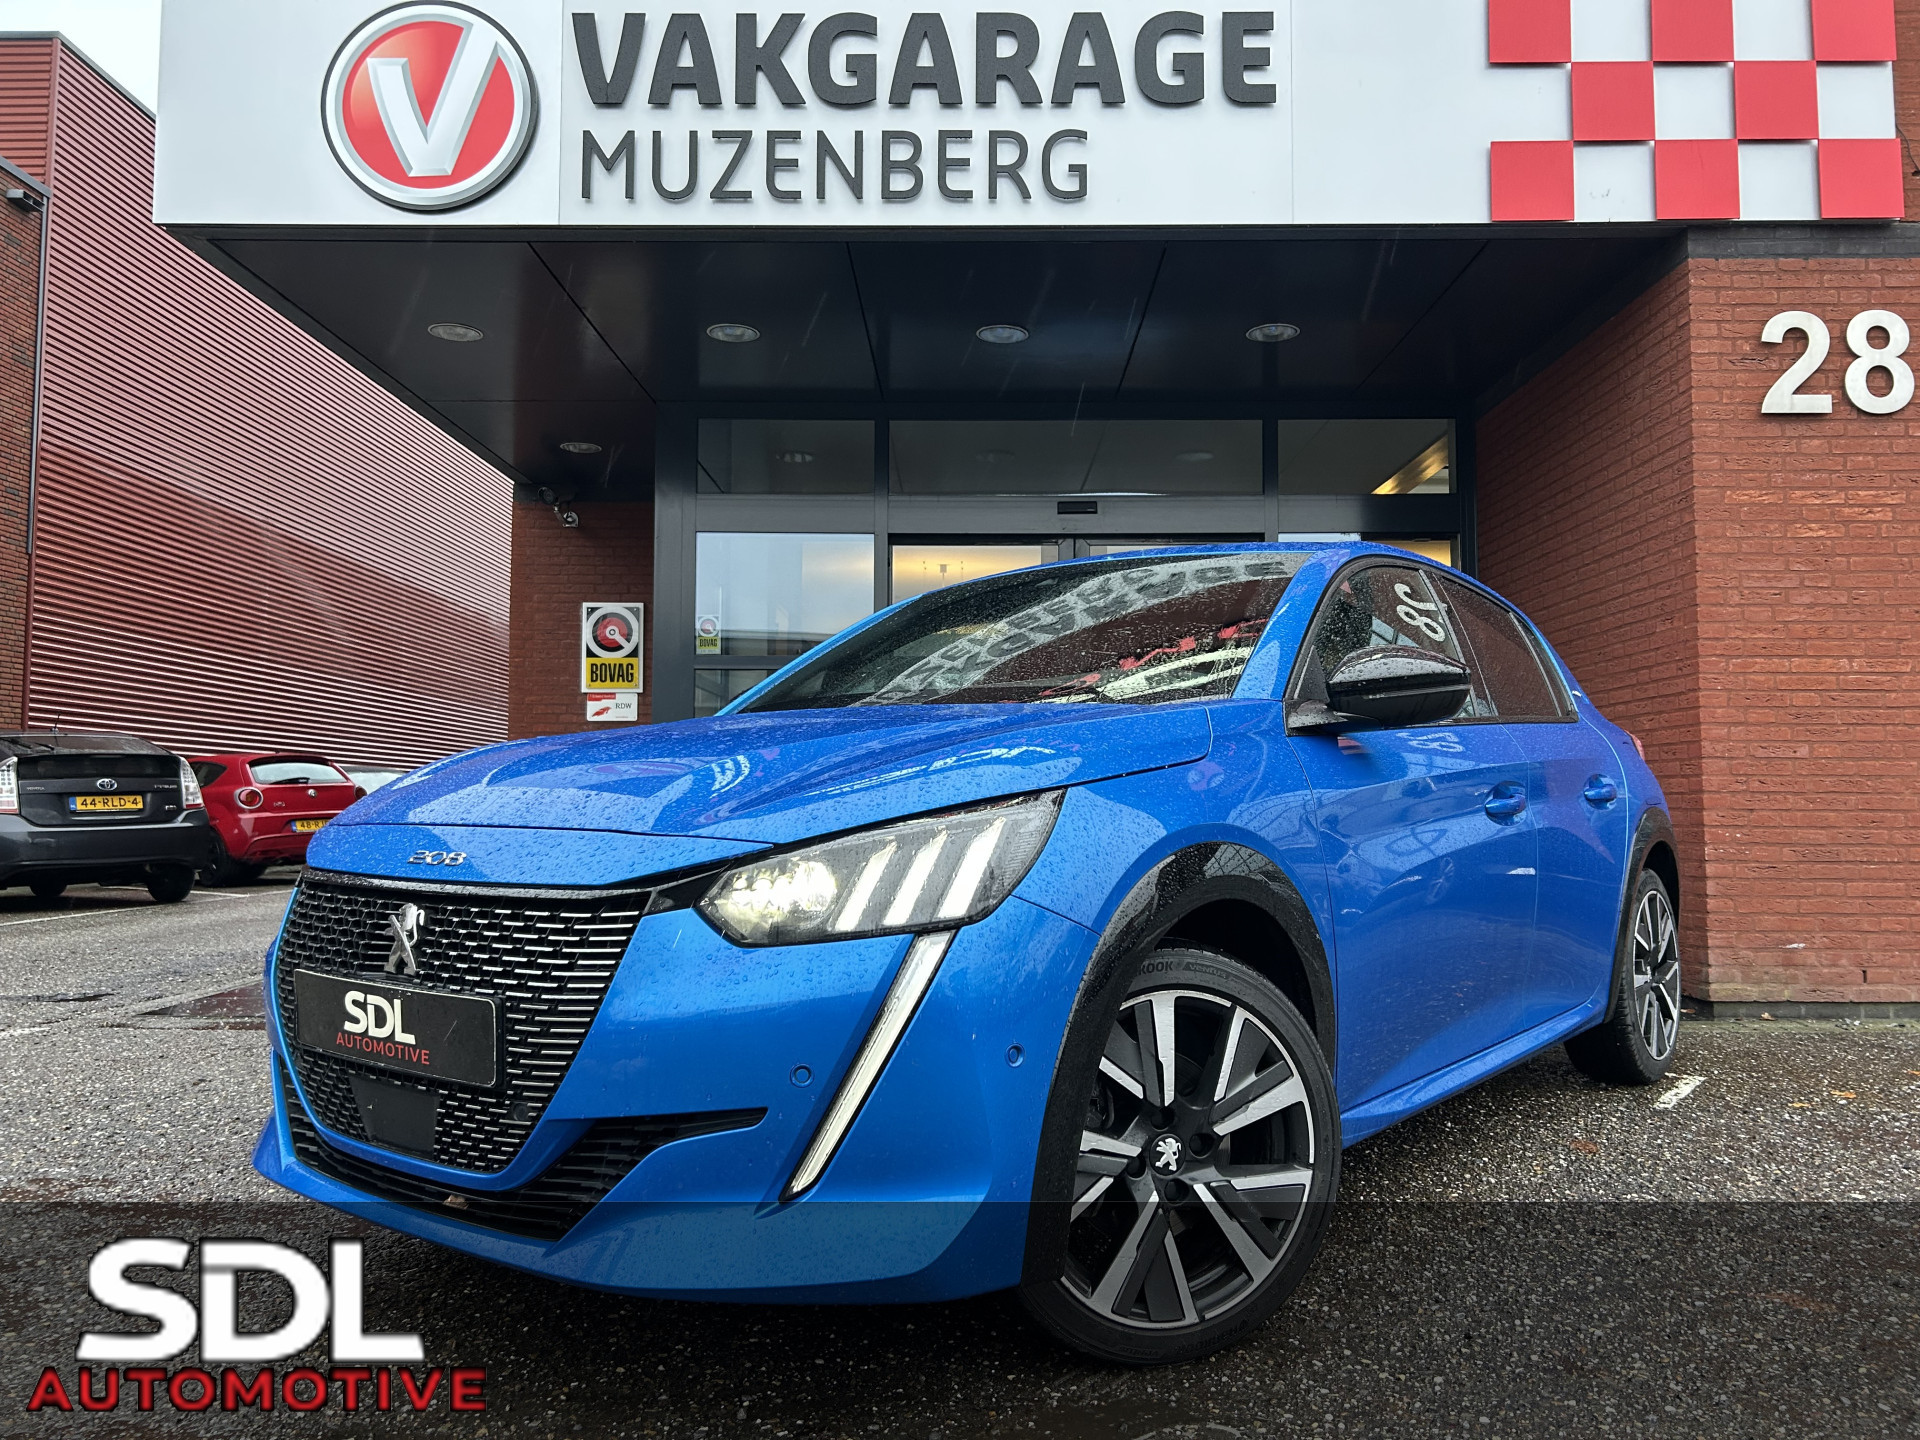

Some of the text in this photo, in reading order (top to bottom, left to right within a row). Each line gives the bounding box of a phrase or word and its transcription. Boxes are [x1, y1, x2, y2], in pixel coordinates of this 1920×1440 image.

[572, 10, 1276, 106] VAKGARAGE
[366, 22, 499, 177] V
[582, 129, 1088, 201] MUZENBERG
[1761, 310, 1915, 414] 28
[590, 662, 635, 683] BOVAG
[80, 796, 139, 809] 44-RLD-4
[407, 849, 467, 866] 208
[343, 990, 416, 1045] SDL
[336, 1031, 430, 1065] AUTOMOTIVE
